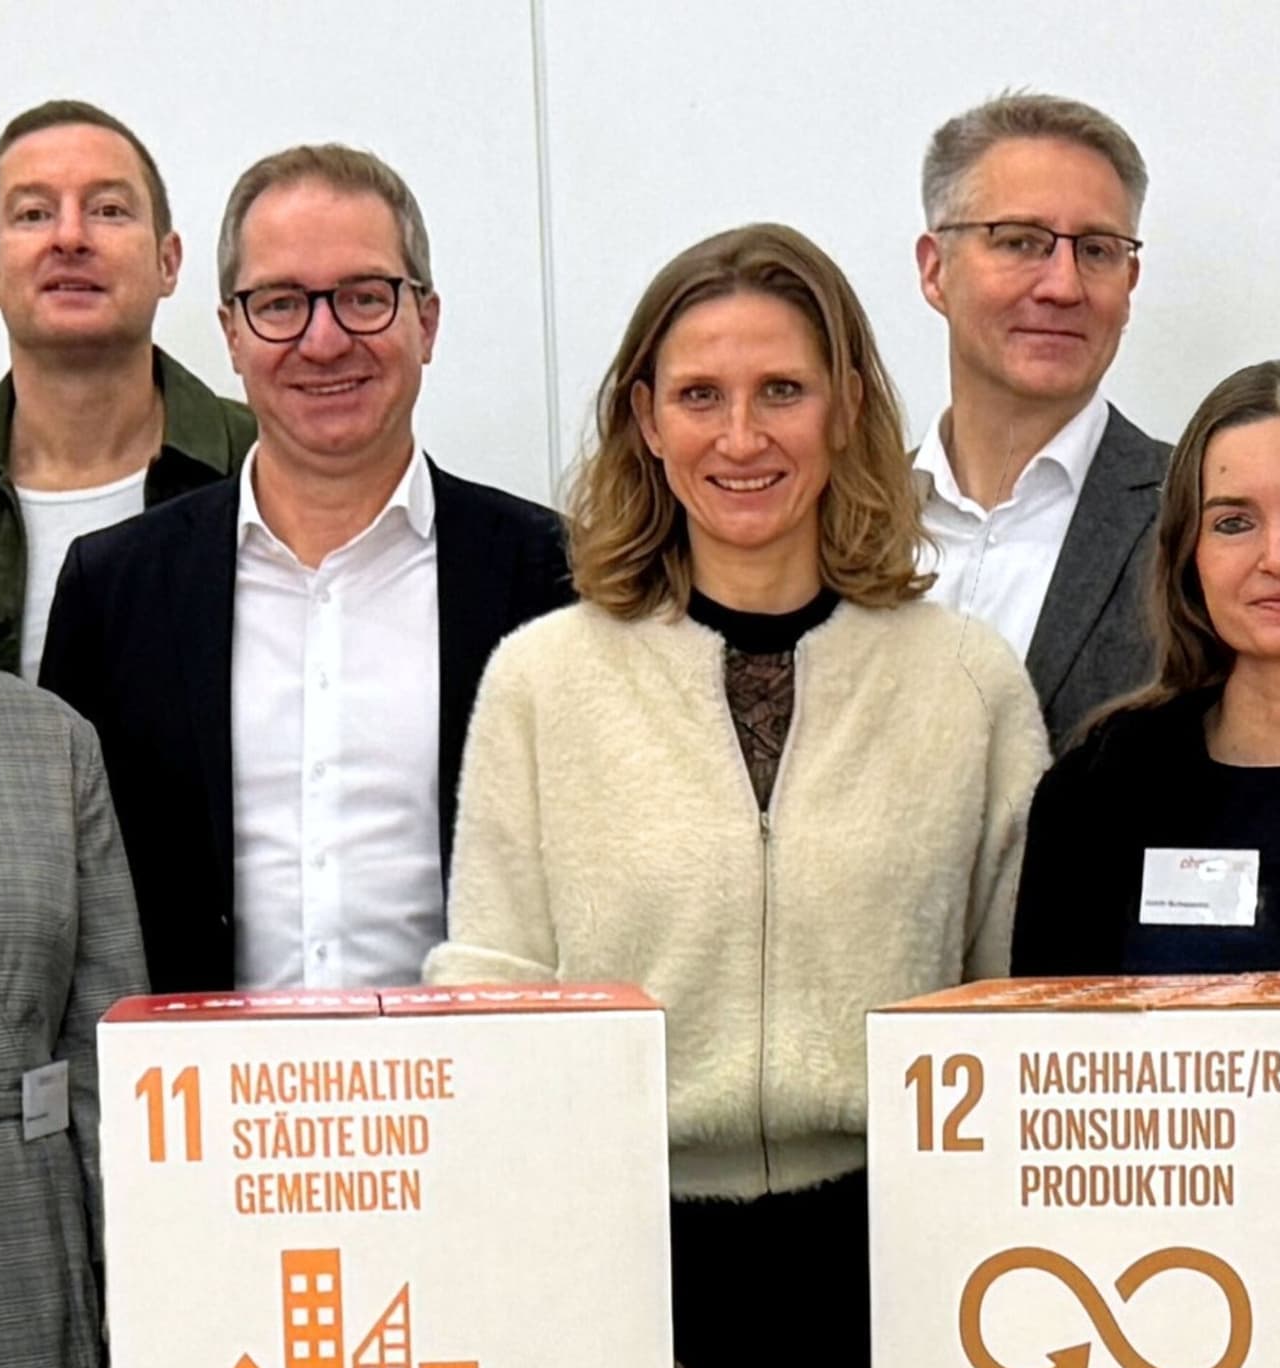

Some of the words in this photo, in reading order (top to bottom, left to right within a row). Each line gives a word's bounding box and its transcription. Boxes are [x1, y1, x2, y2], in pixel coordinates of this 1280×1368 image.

[231, 1059, 454, 1104] NACHHALTIGE
[905, 1054, 984, 1152] 12
[136, 1066, 202, 1162] 11
[233, 1112, 354, 1159] STÄDTE
[363, 1115, 428, 1156] UND
[1021, 1108, 1159, 1150] KONSUM
[1168, 1108, 1235, 1150] UND
[236, 1170, 420, 1214] GEMEINDEN
[1021, 1165, 1233, 1206] PRODUKTION
